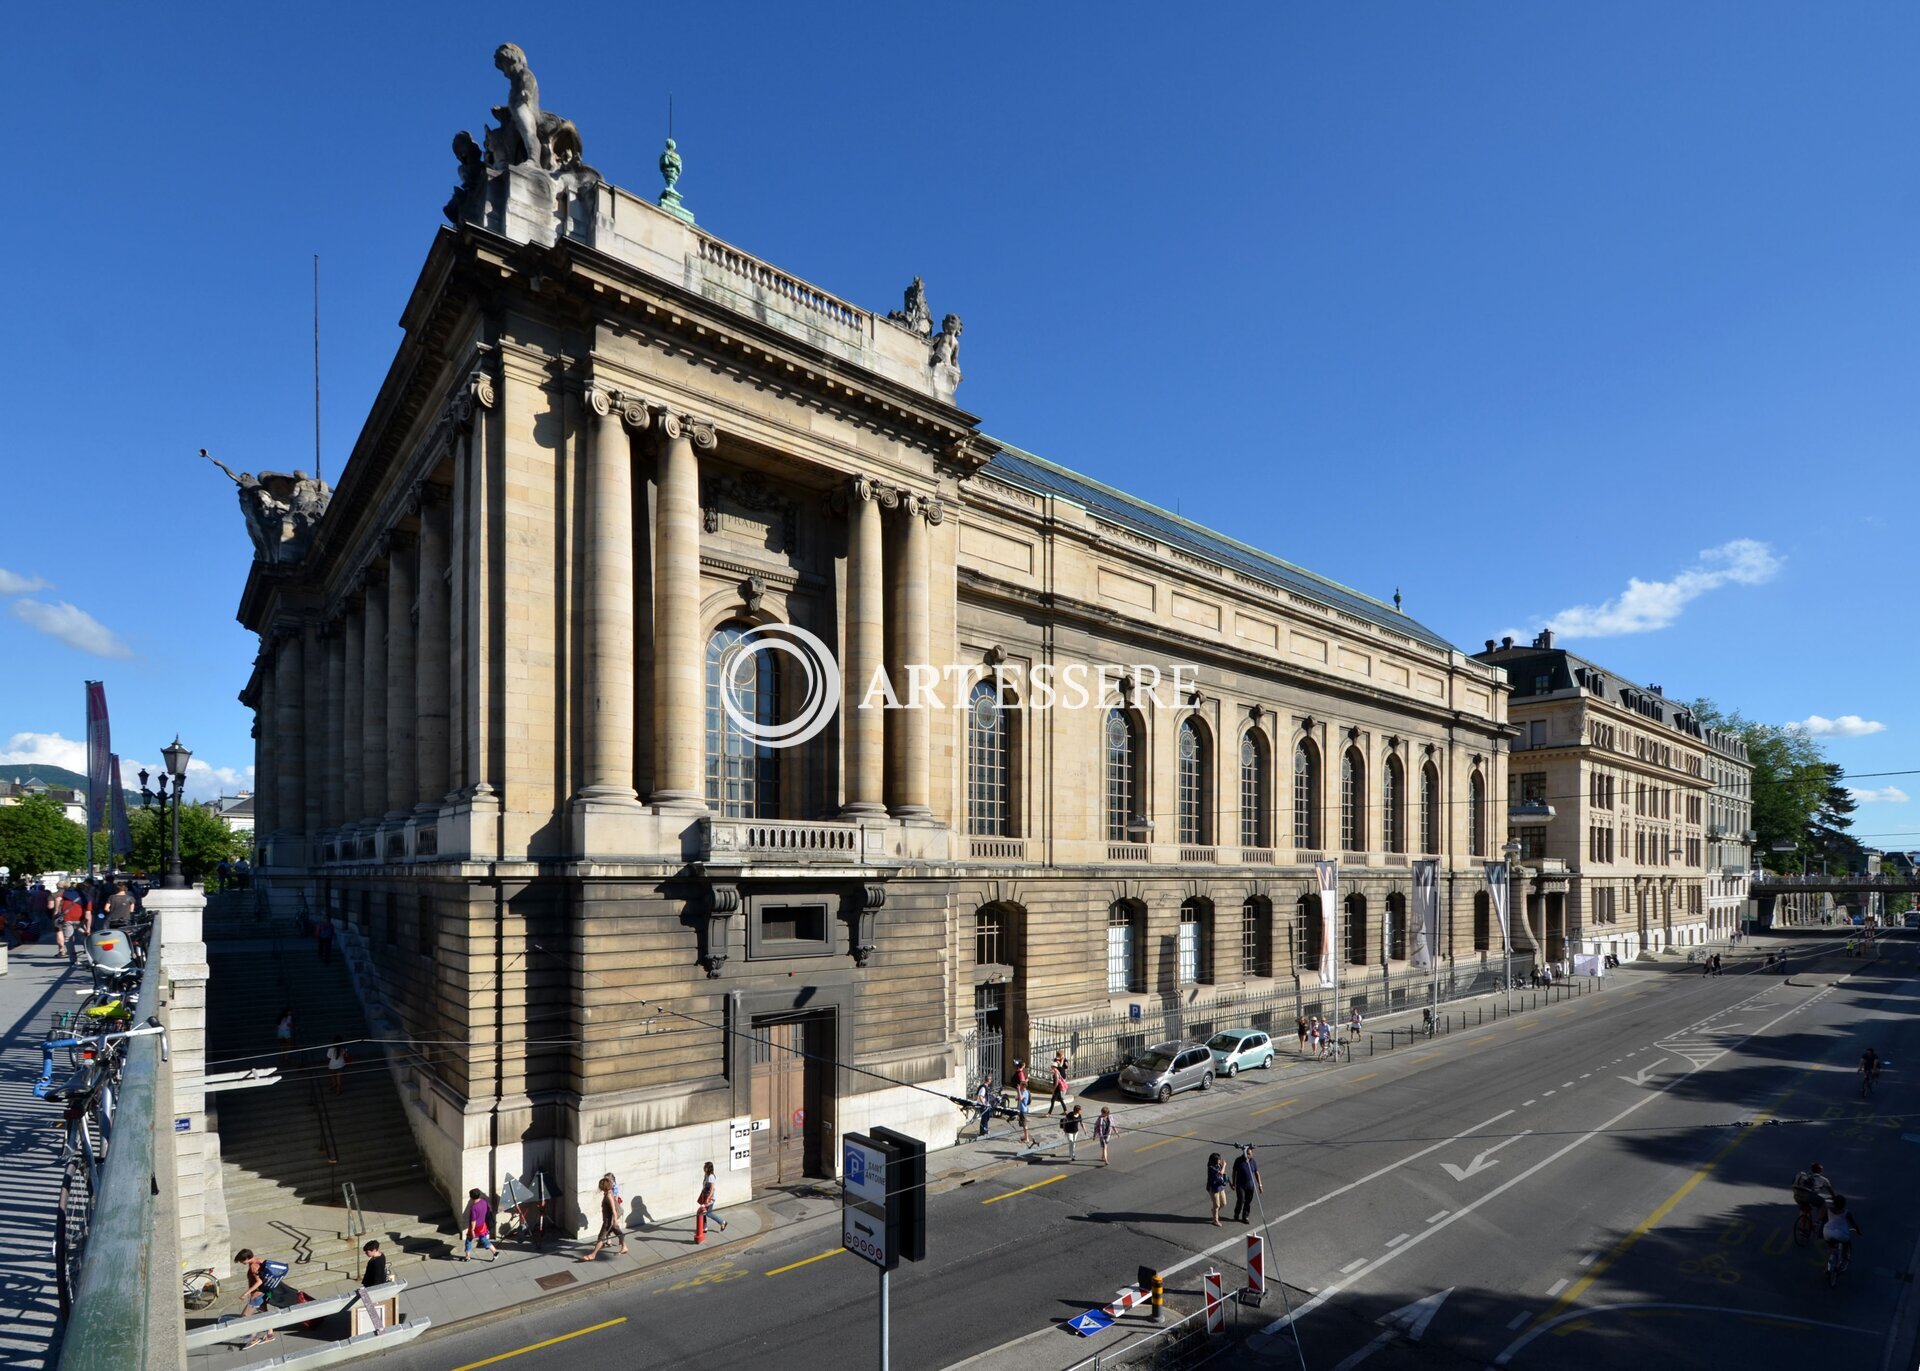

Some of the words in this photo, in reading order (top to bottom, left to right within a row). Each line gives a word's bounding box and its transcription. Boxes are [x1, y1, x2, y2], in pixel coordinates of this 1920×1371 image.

[1132, 1006, 1139, 1017] P
[851, 1157, 860, 1178] P
[868, 1161, 882, 1174] SAINT
[865, 1171, 886, 1186] ANTOINE
